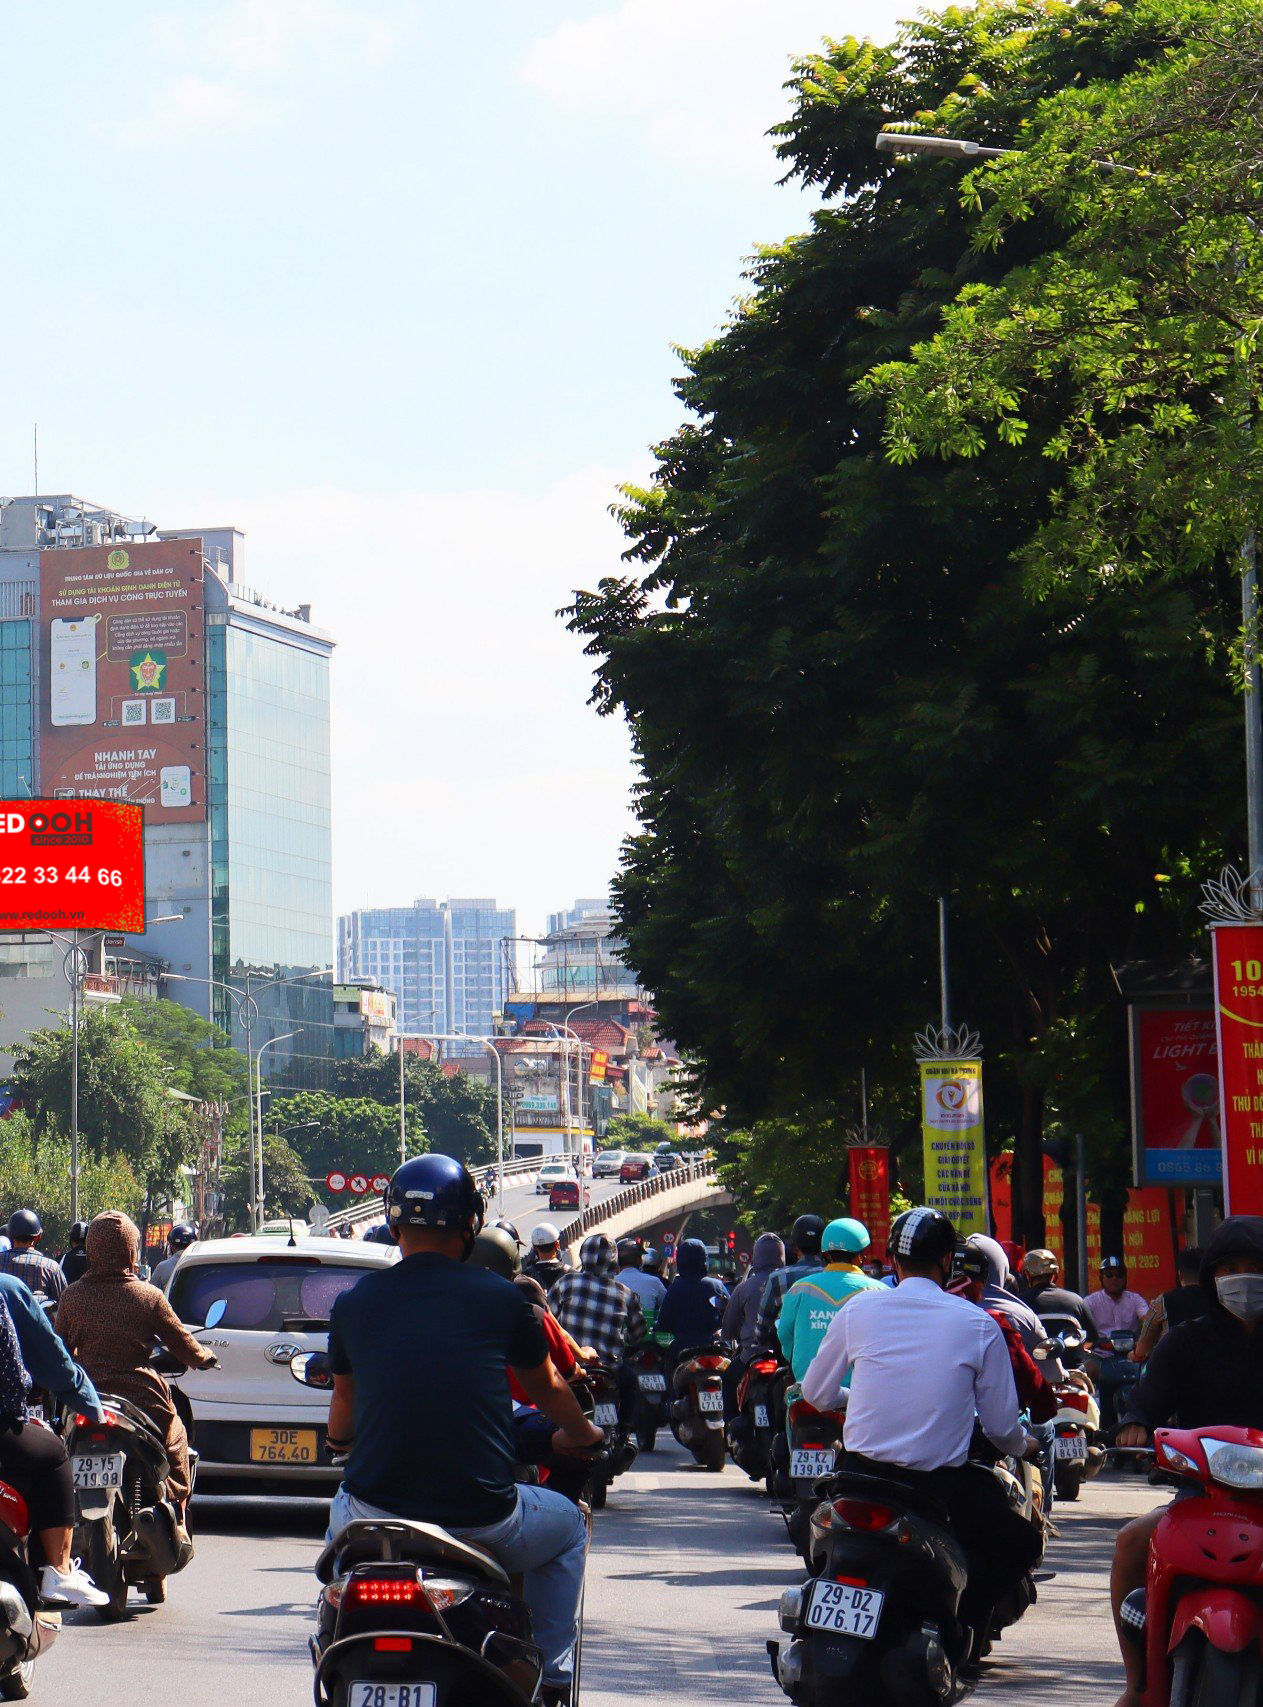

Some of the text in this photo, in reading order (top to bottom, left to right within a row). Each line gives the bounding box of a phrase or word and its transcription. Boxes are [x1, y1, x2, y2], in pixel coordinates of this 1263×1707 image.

[138, 582, 157, 590] DANH
[51, 598, 73, 606] THAM
[89, 595, 108, 604] DỊCH
[120, 592, 144, 602] CÔNG
[145, 590, 165, 600] TRỰC
[165, 588, 188, 598] TUYẾN
[95, 748, 157, 762] NHANH TAY
[125, 760, 145, 770] DỤNG
[79, 788, 107, 798] THAY
[34, 835, 89, 844] since 2010
[33, 866, 59, 884] 33
[65, 866, 91, 884] 44
[97, 868, 123, 887] 66
[1153, 1042, 1207, 1059] LIGHT
[1232, 1090, 1251, 1112] THỦ
[1139, 1255, 1160, 1268] 2023
[809, 1310, 836, 1320] XAN
[270, 1430, 299, 1446] 30E
[259, 1445, 310, 1461] 764.40
[77, 1457, 115, 1472] 29-Y5
[793, 1464, 831, 1476] 139.81
[73, 1472, 119, 1487] 219.98
[821, 1584, 873, 1612] 29-D2
[811, 1604, 875, 1634] 076.17
[361, 1685, 421, 1707] 28-B1
